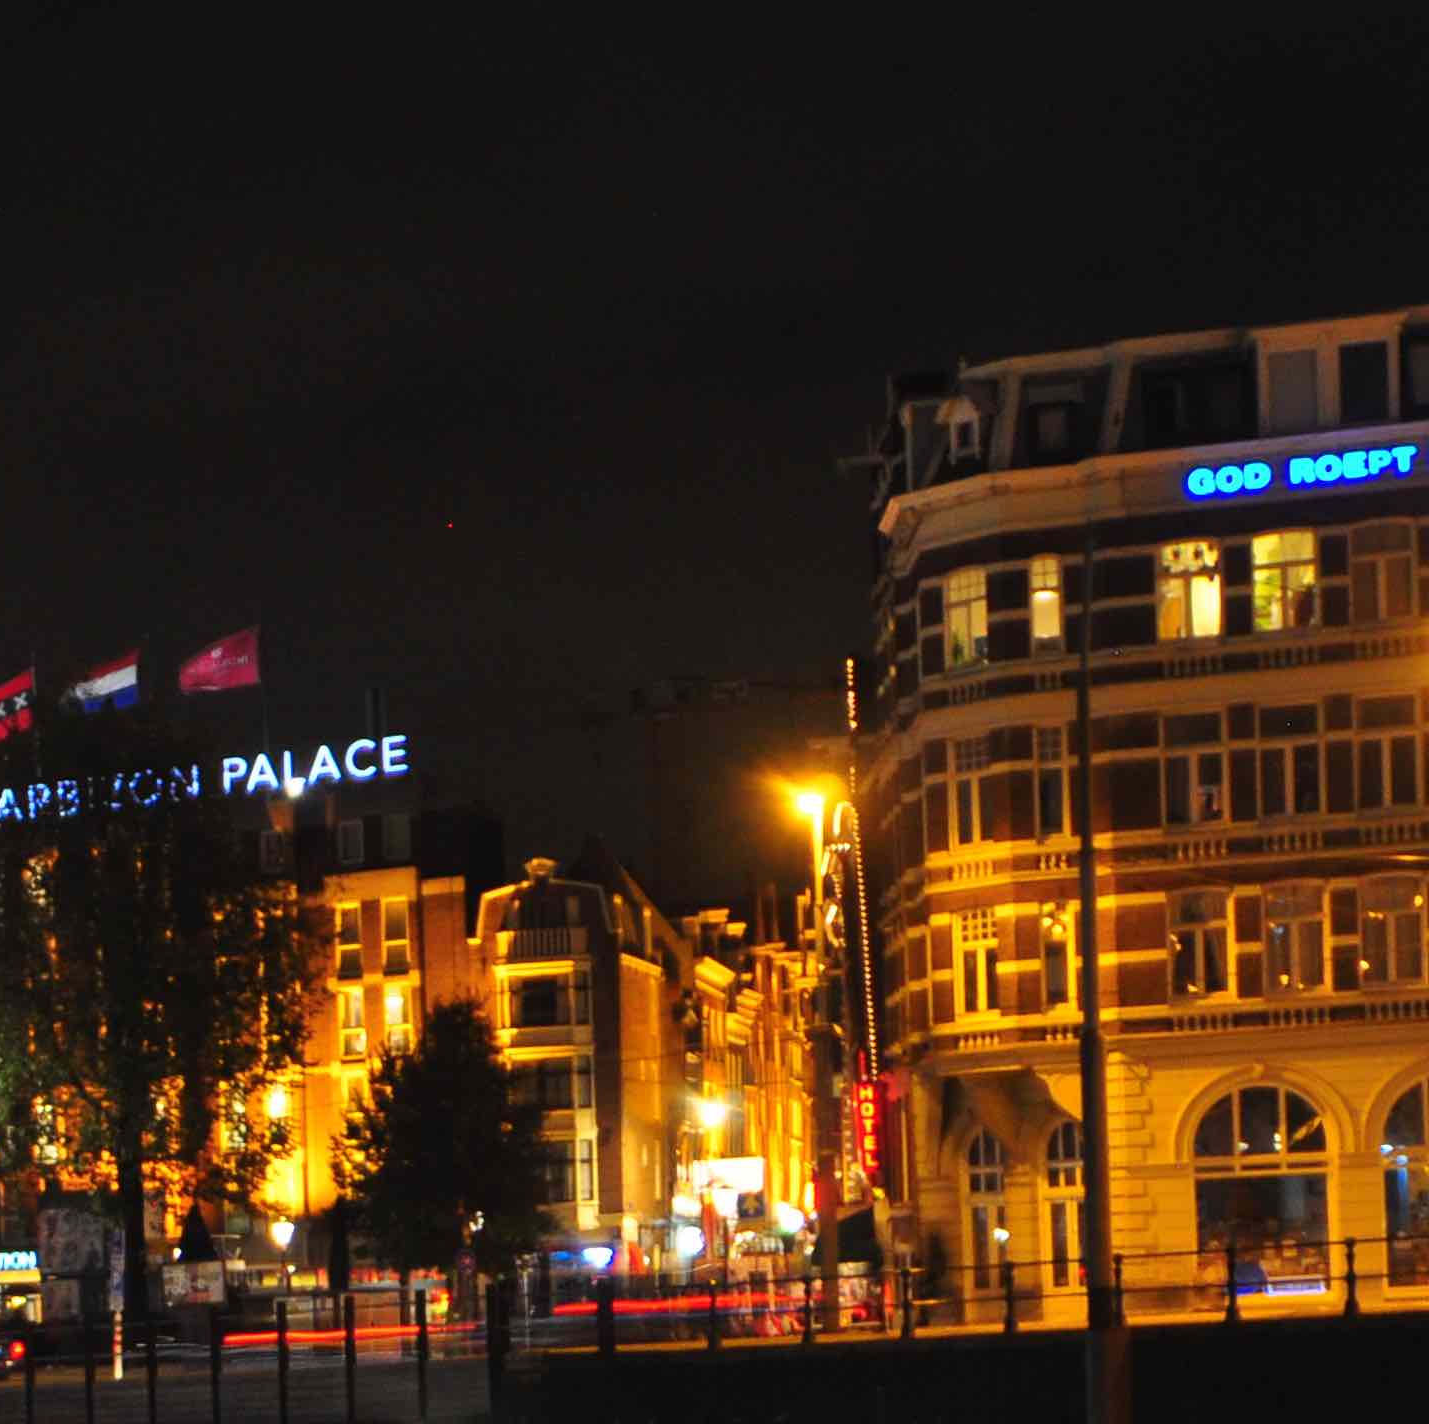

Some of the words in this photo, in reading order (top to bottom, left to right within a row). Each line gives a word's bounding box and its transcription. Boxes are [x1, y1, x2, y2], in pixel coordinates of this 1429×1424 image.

[1187, 462, 1272, 496] GOD
[1290, 445, 1418, 485] ROEPT
[222, 734, 409, 796] PALACE
[858, 1084, 880, 1168] HOTEL
